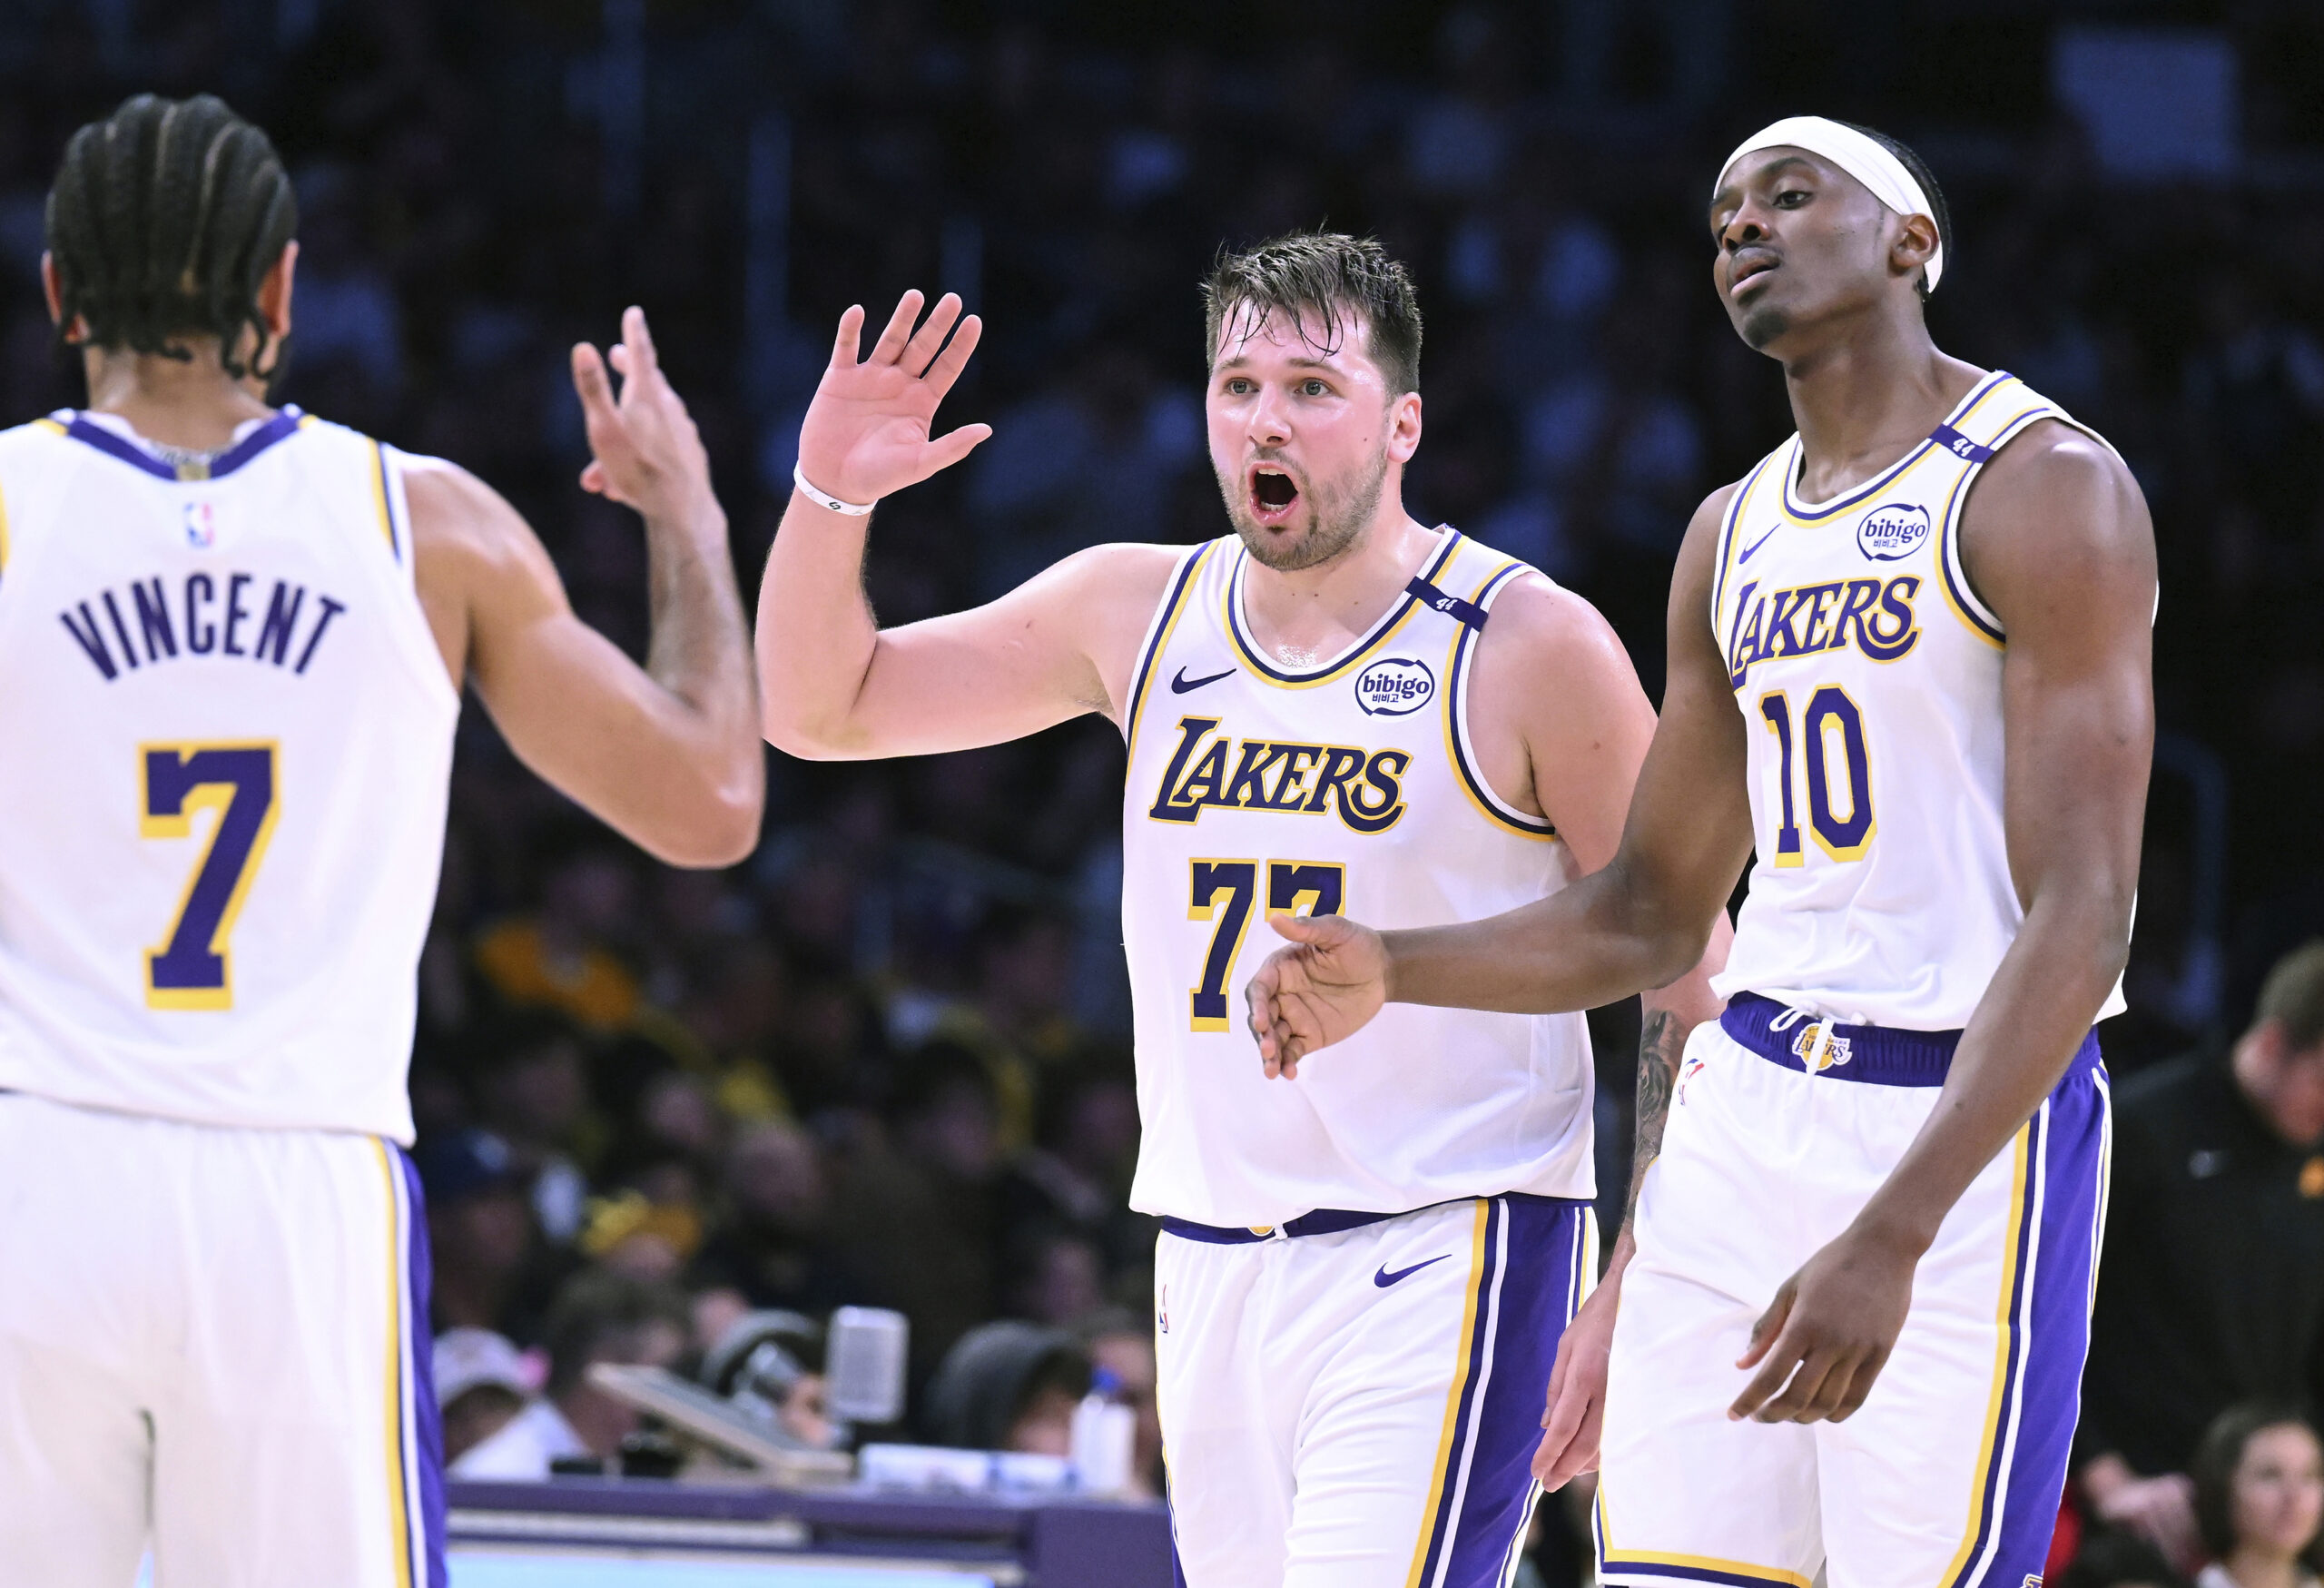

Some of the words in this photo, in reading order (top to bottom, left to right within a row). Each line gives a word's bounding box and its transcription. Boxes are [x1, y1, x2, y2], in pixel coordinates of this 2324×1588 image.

[1953, 438, 1975, 458] 44
[1865, 518, 1925, 544] bibigo
[1873, 539, 1898, 548] 비비고
[1436, 597, 1459, 611] 44
[61, 573, 347, 681] VINCENT
[1728, 574, 1925, 694] LAKERS
[1363, 673, 1430, 699] bibigo
[1372, 694, 1400, 703] 비비고
[1147, 716, 1413, 835] LAKERS
[1758, 683, 1877, 868] 10
[137, 738, 282, 1011] 7
[1794, 1032, 1847, 1062] LARS
